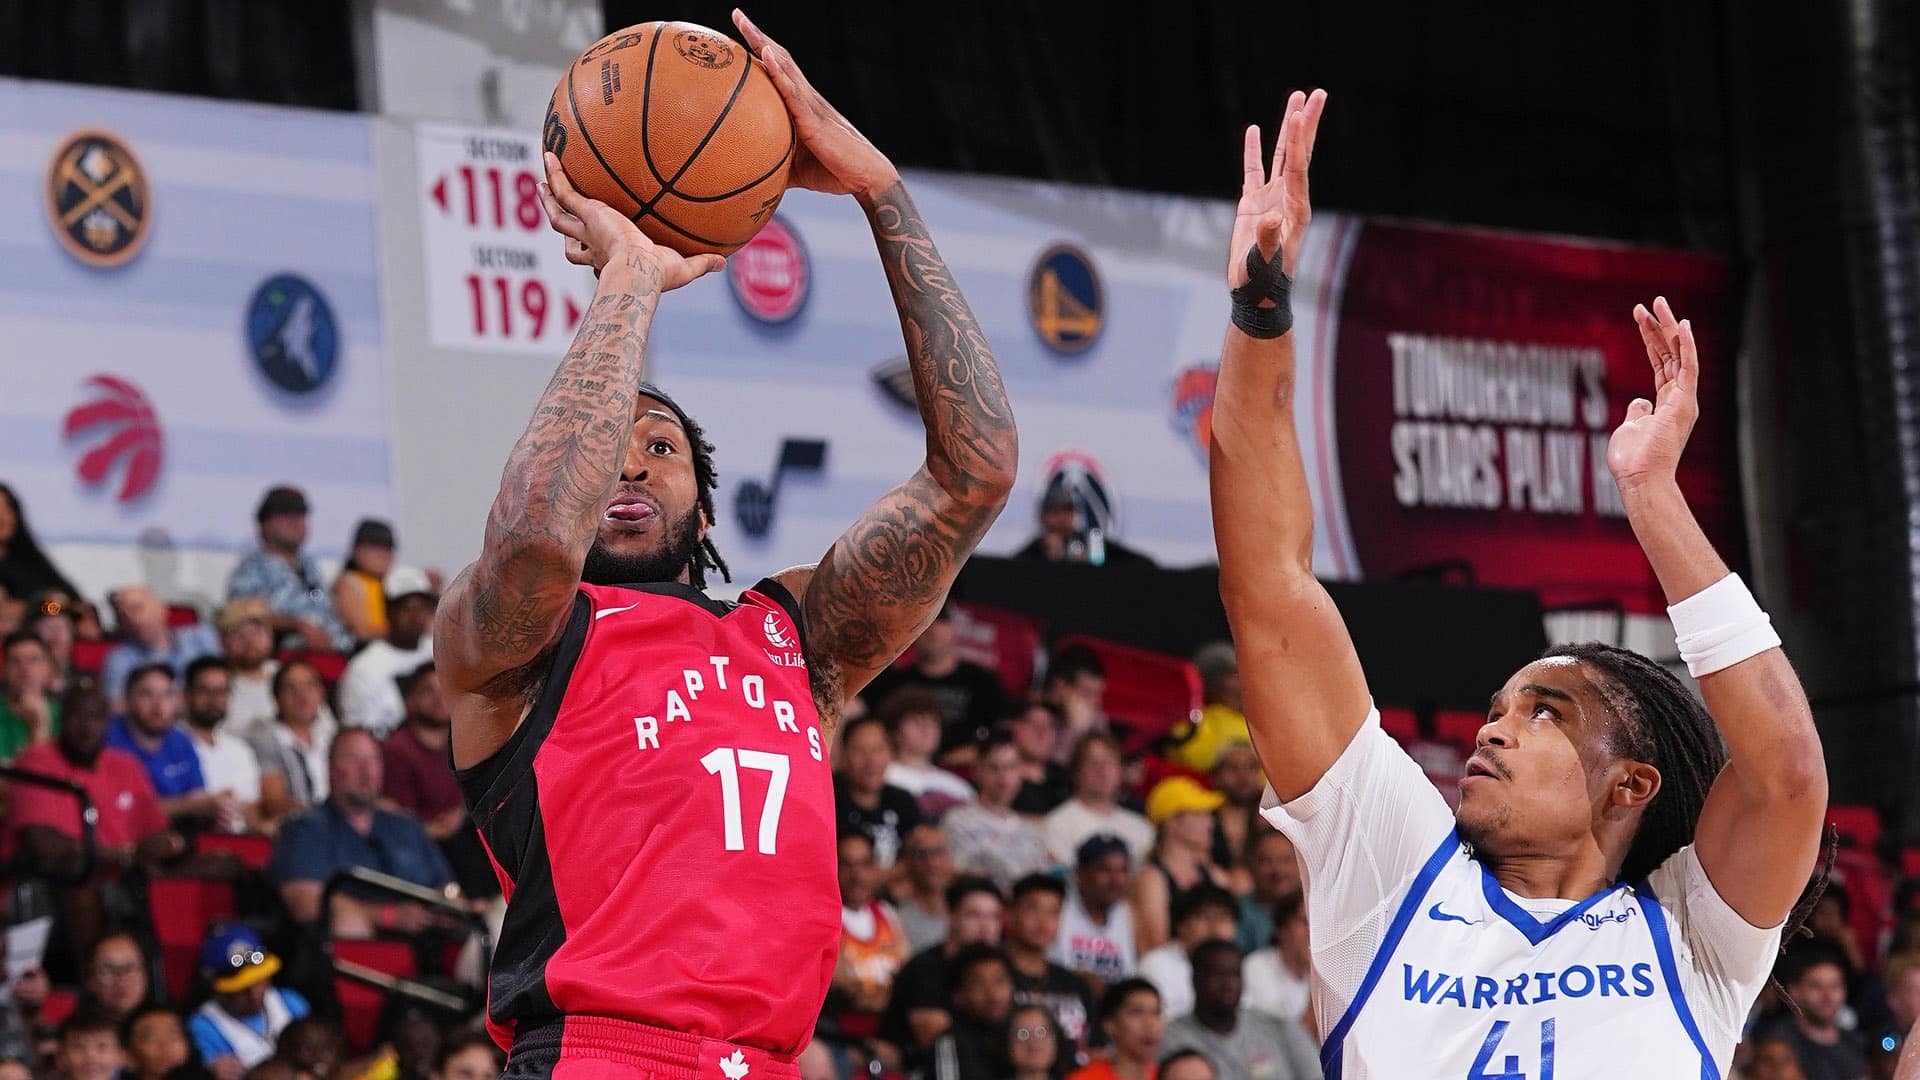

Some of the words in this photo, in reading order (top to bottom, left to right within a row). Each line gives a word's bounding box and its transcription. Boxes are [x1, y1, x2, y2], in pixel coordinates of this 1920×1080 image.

[459, 165, 542, 232] 118
[466, 274, 547, 339] 119
[1387, 333, 1609, 428] TOMORROW'S
[1392, 421, 1502, 508] STARS
[1505, 427, 1585, 514] PLAY
[784, 652, 806, 669] Life
[634, 656, 822, 762] RAPTORS
[700, 747, 790, 854] 17
[1403, 963, 1655, 1009] WARRIORS
[1467, 1017, 1555, 1080] 41
